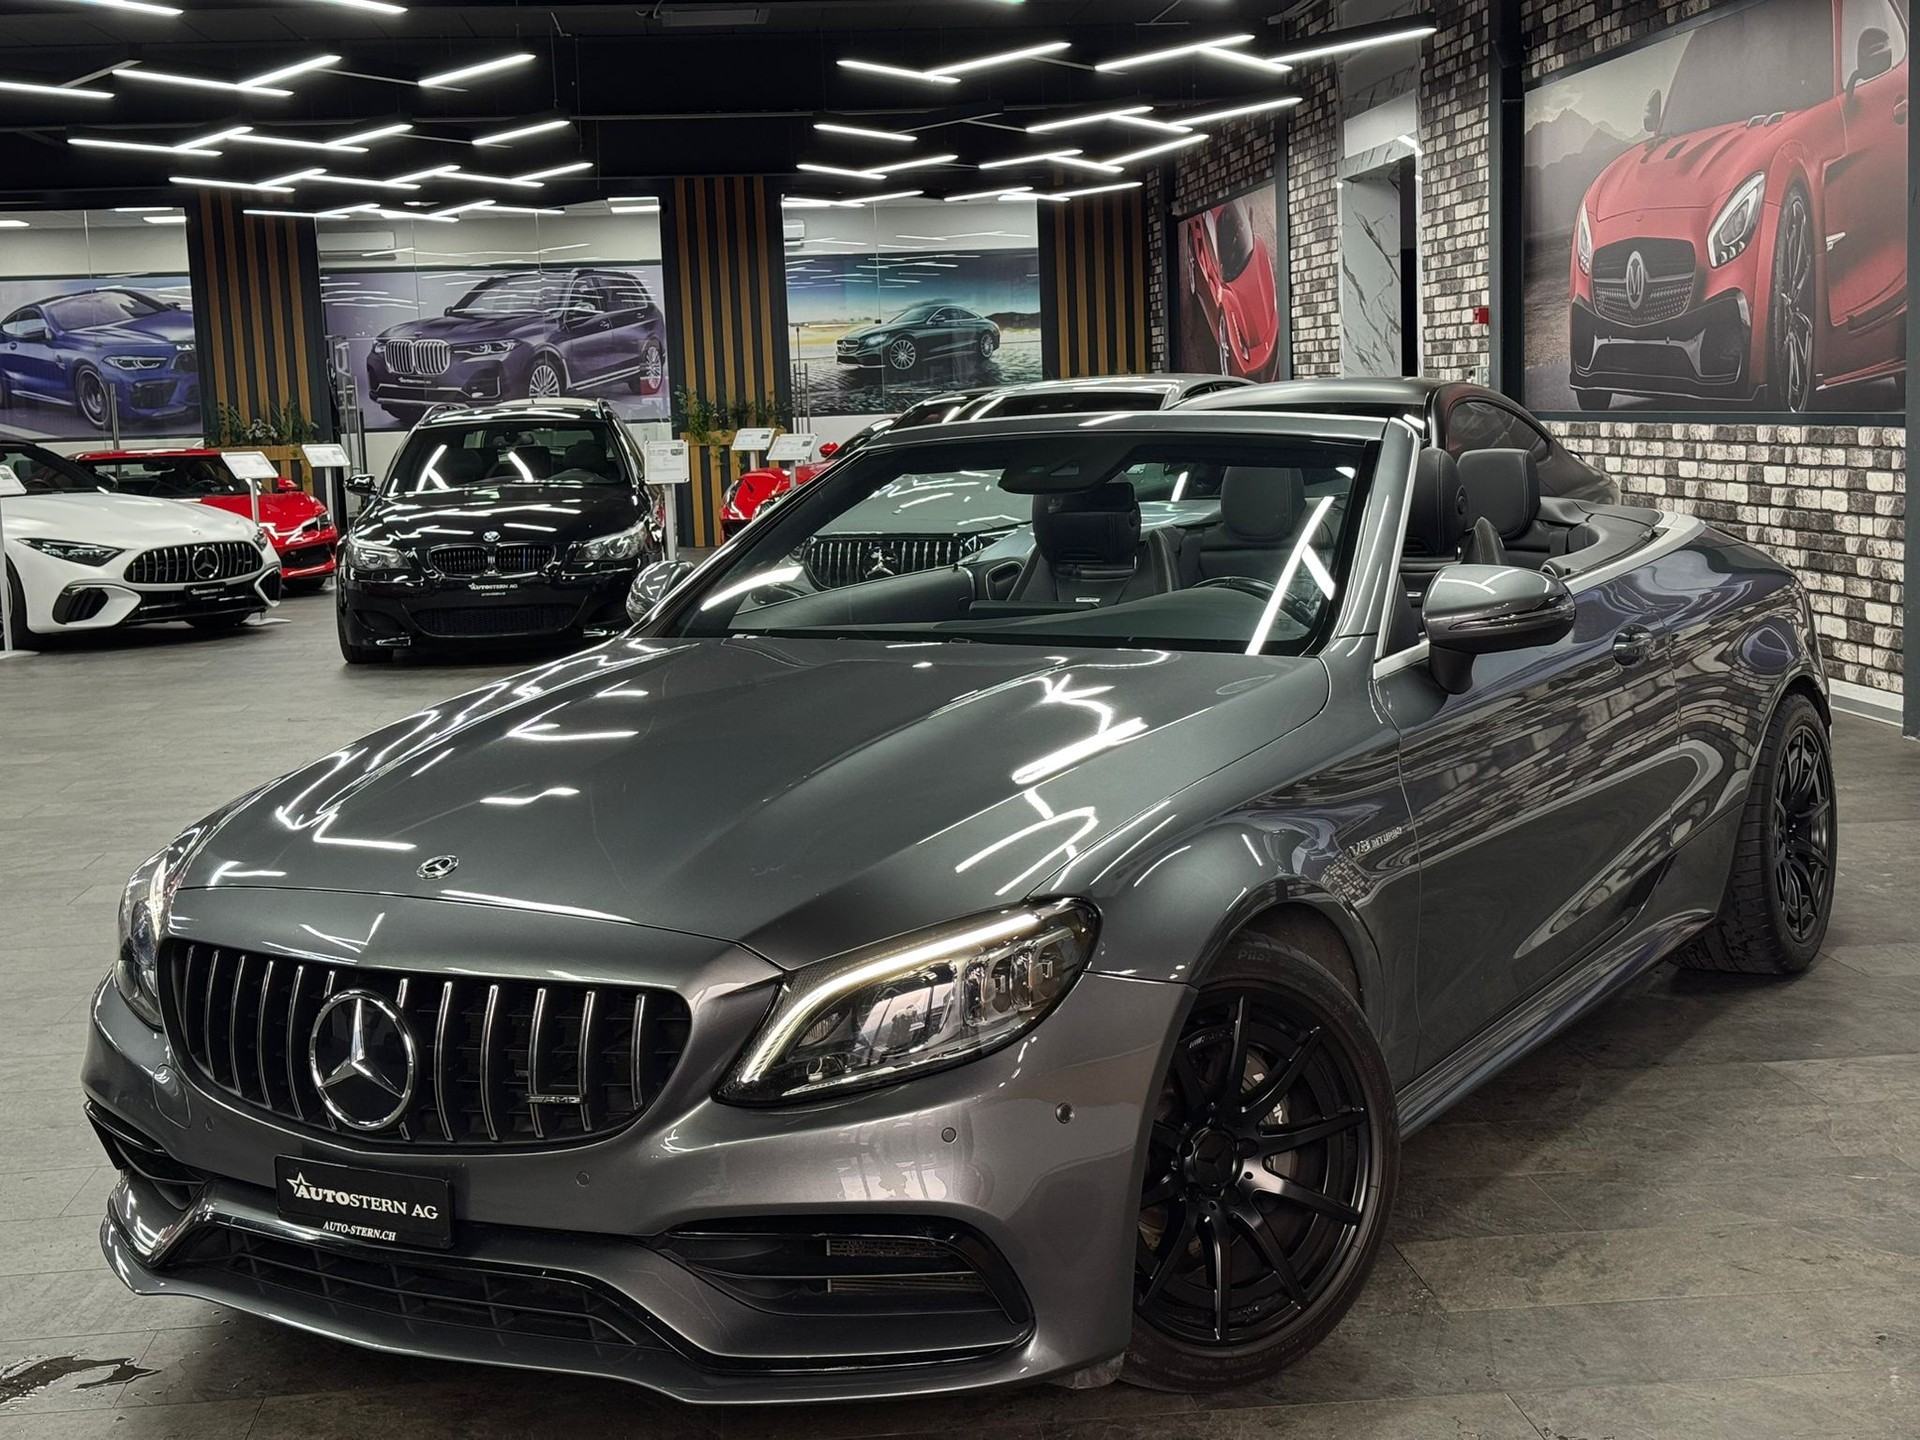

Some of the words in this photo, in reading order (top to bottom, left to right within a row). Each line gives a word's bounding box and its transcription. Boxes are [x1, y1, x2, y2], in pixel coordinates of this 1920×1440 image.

[1349, 840, 1371, 856] V8
[296, 1184, 407, 1216] AUTOSTERN
[411, 1203, 439, 1220] AG
[322, 1220, 397, 1242] AUTO-STERN.CH
